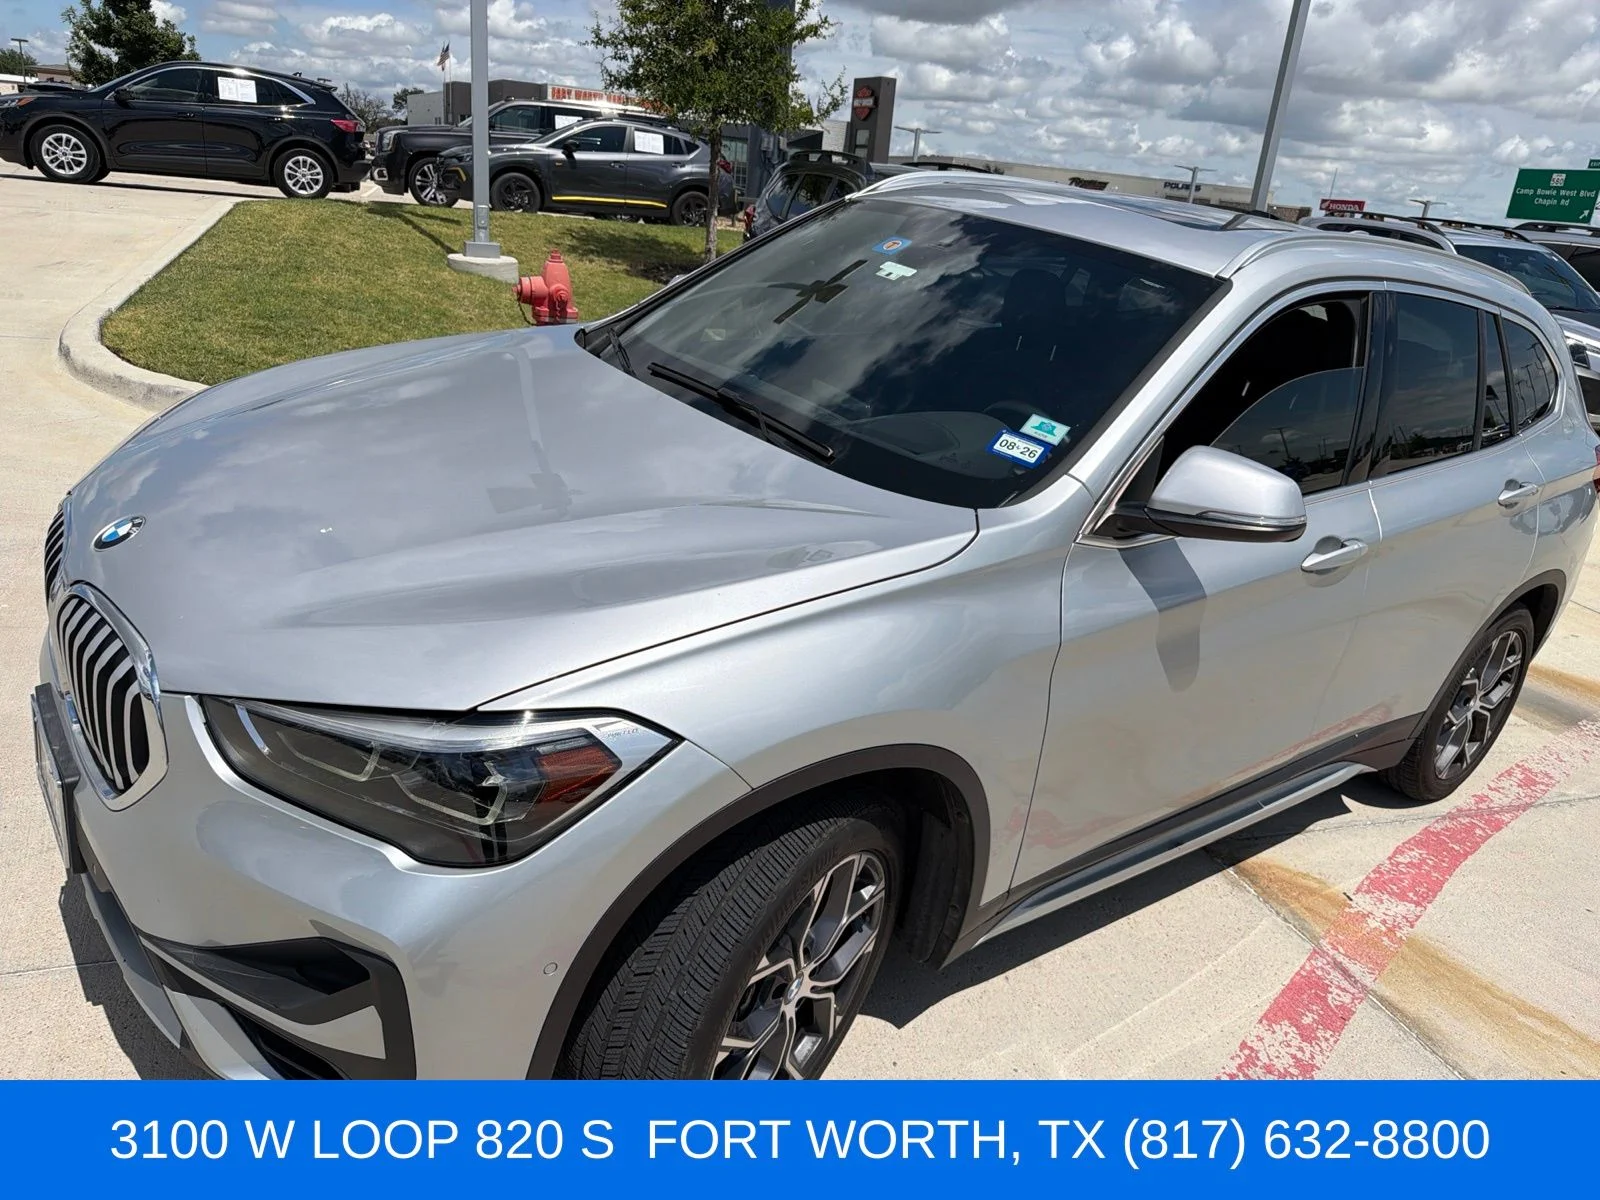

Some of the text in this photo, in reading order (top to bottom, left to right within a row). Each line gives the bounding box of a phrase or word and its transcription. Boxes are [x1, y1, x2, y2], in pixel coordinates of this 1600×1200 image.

[1164, 181, 1202, 193] POLARS
[1516, 187, 1534, 195] Camp
[1560, 189, 1577, 197] West
[1579, 190, 1596, 198] Blvd
[1534, 198, 1557, 206] Chapin
[1330, 203, 1360, 211] HONDA
